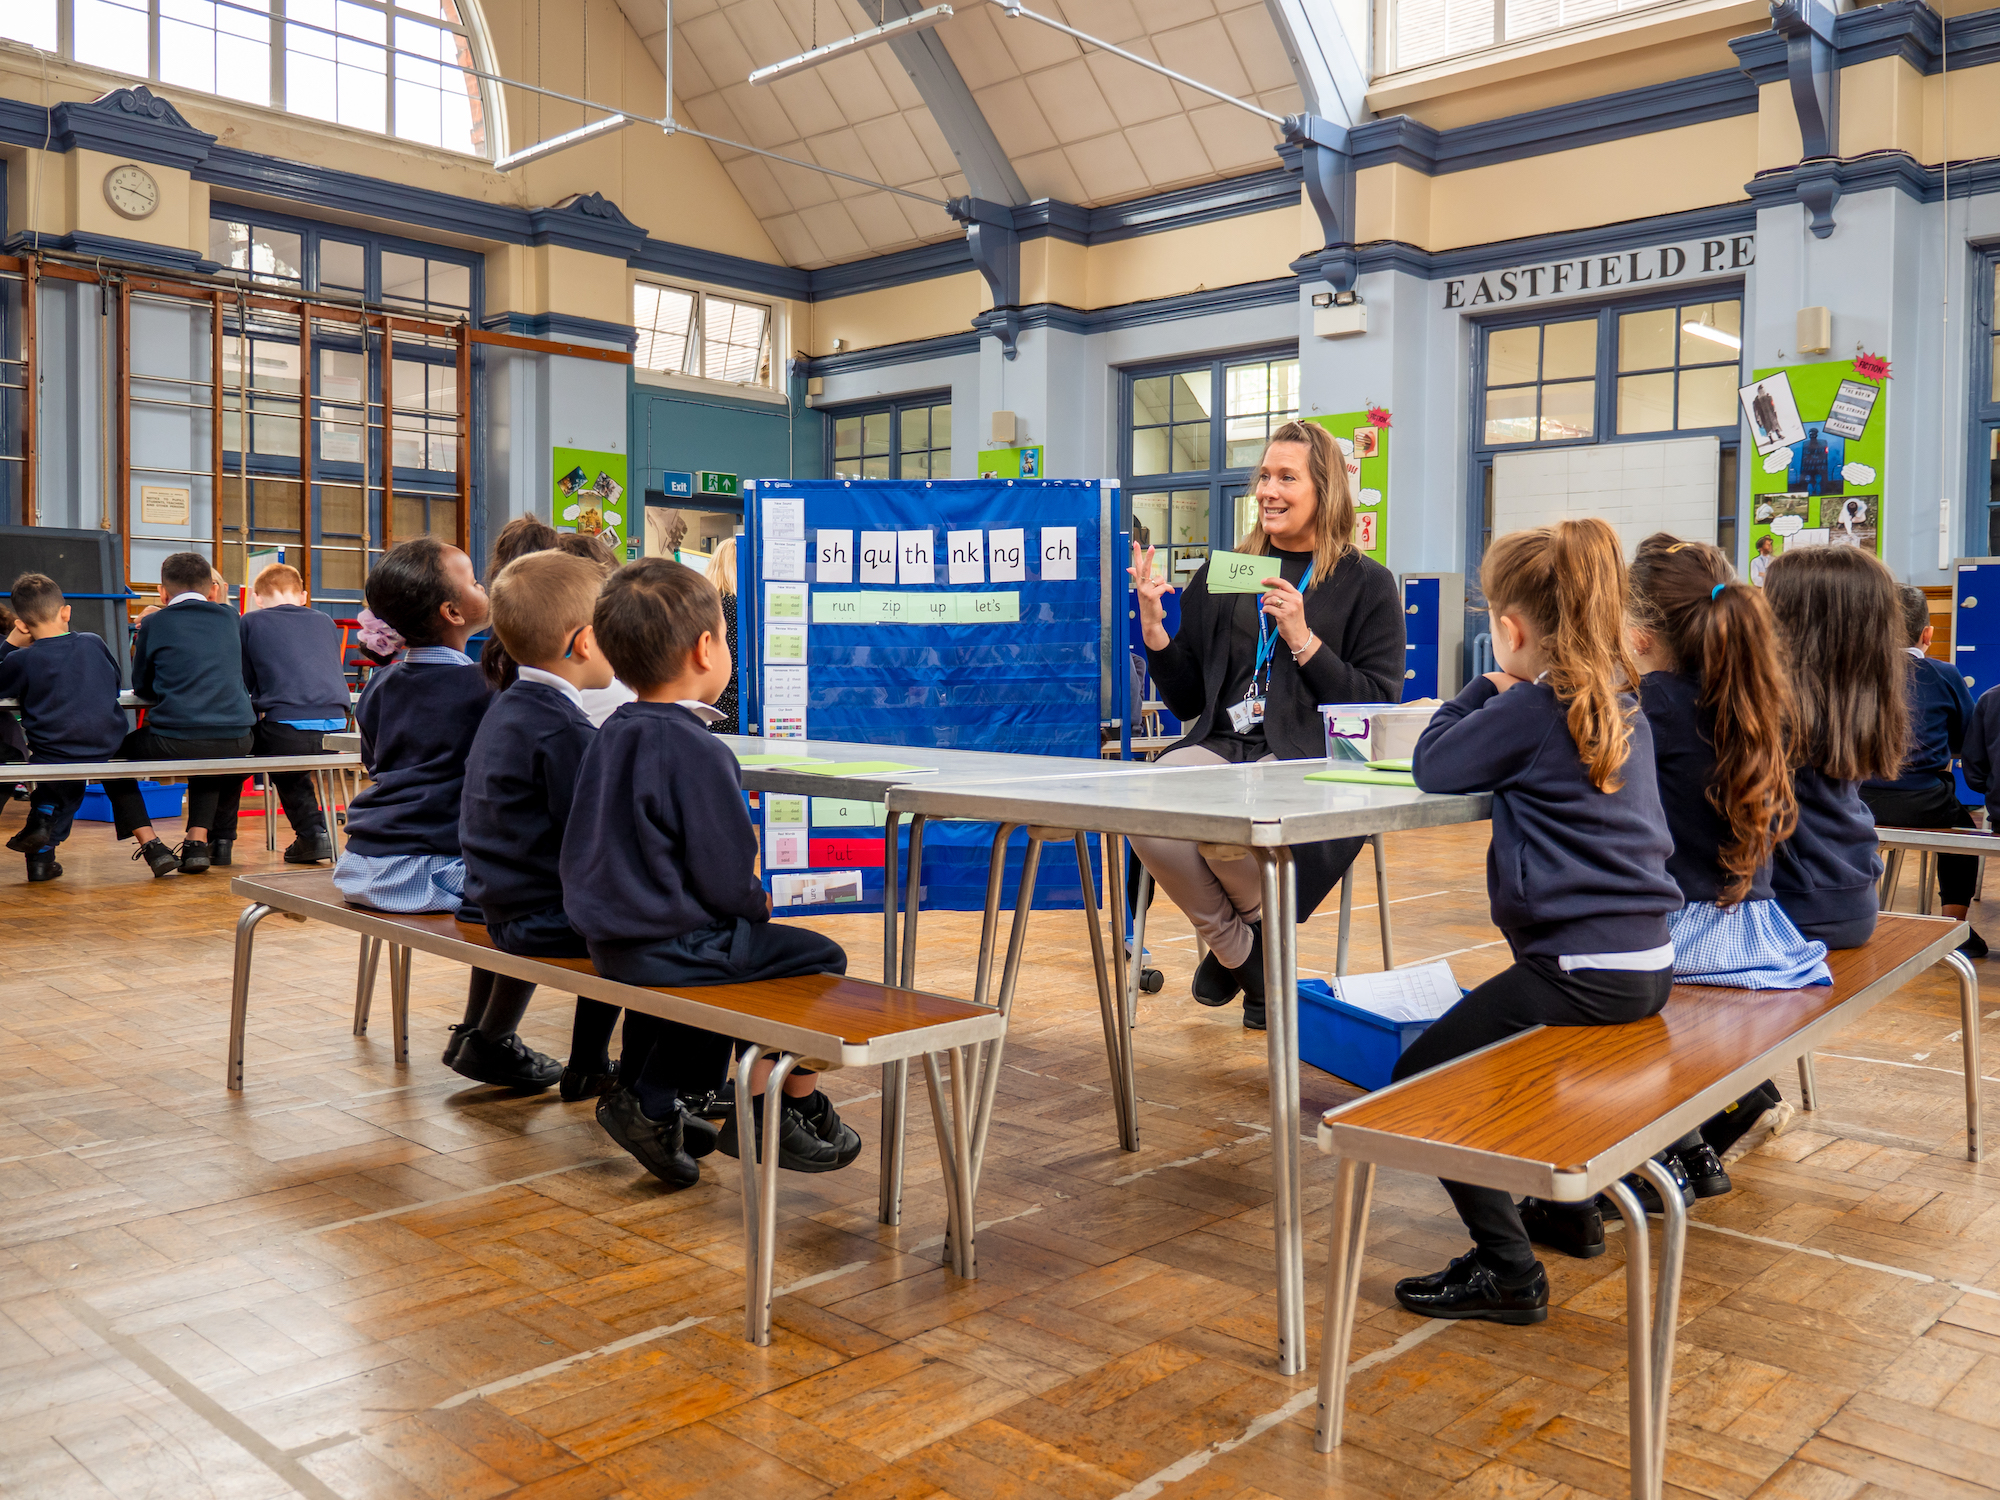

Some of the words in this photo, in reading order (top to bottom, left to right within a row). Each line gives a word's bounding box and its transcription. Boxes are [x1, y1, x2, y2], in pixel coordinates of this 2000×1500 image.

[1442, 247, 1686, 309] EASTFIELD
[1858, 361, 1884, 374] FICTION
[1846, 407, 1866, 416] STRIPED
[1833, 422, 1856, 432] PAJAMAS
[671, 481, 687, 492] Exit
[821, 542, 847, 564] sh
[863, 547, 892, 569] qu
[905, 543, 928, 564] th
[952, 542, 979, 563] nk
[994, 546, 1020, 568] ng
[1045, 539, 1072, 561] ch
[1229, 563, 1255, 579] yes
[832, 601, 855, 612] run
[882, 600, 901, 615] zip
[930, 602, 946, 616] up
[975, 599, 1001, 612] let's
[839, 807, 848, 817] a
[827, 843, 853, 861] Put
